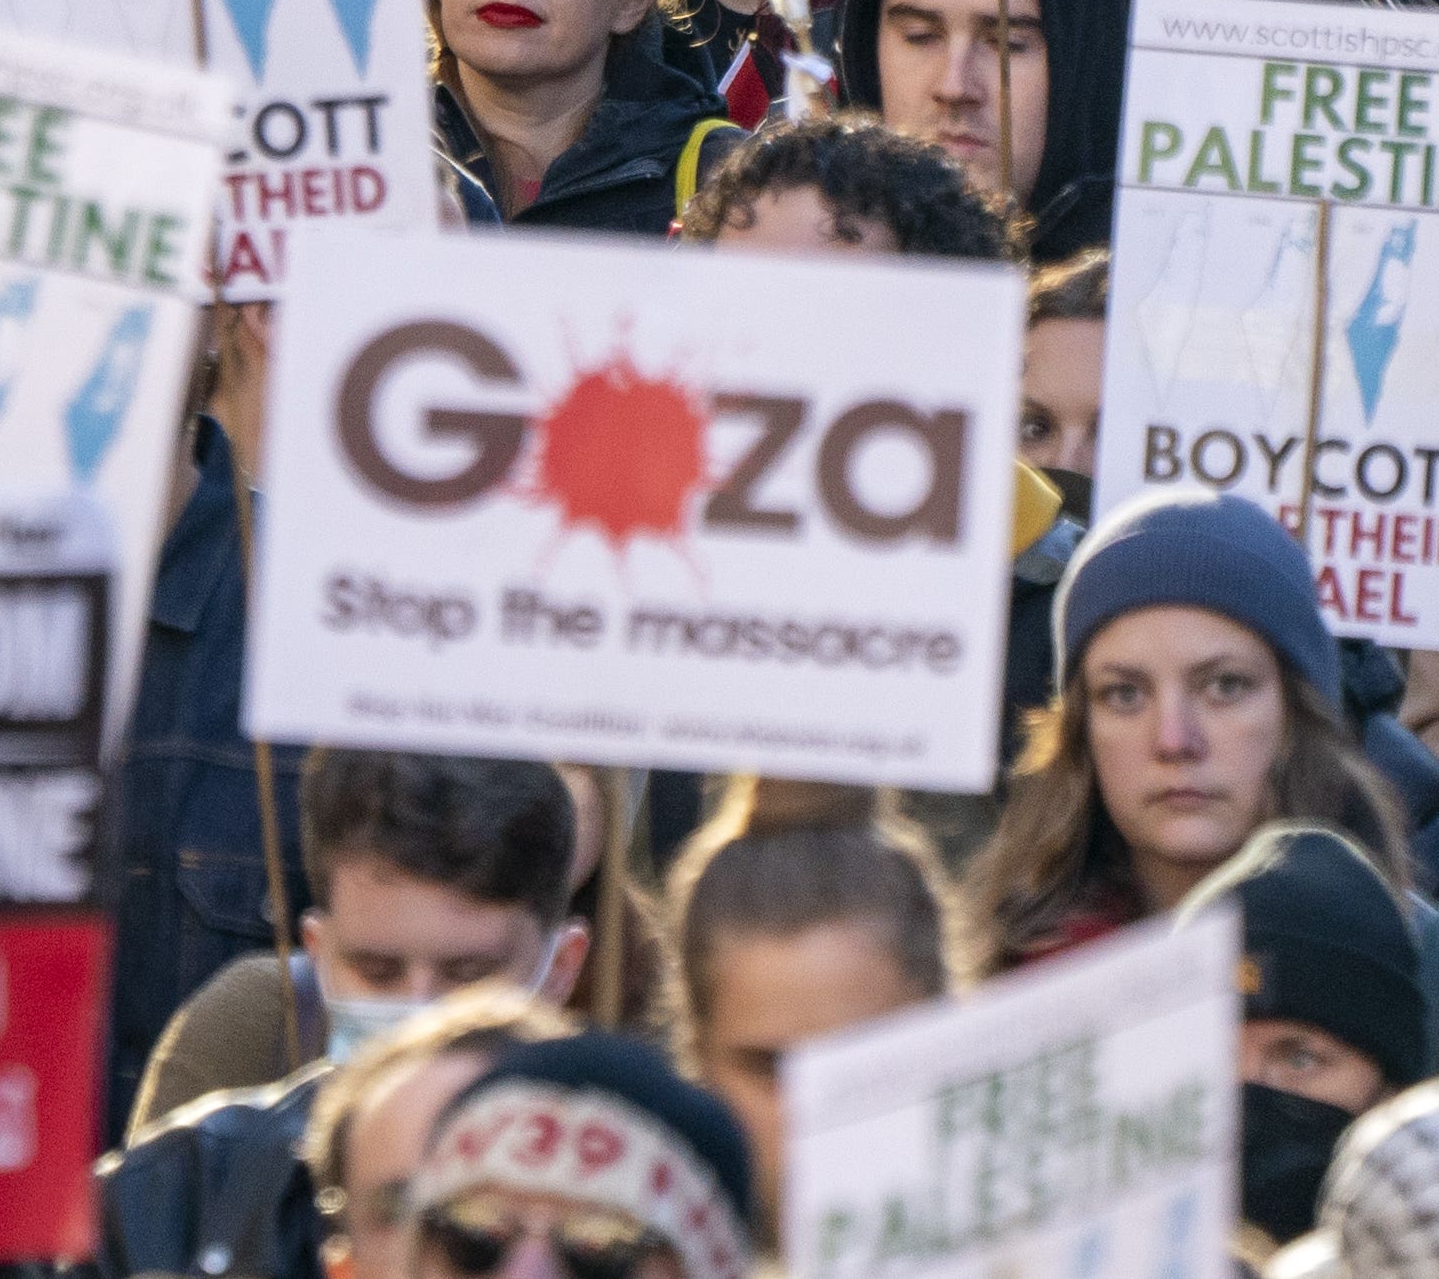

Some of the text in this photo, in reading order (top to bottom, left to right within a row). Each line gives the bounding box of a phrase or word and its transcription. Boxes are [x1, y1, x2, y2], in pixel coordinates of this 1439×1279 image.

[1259, 62, 1433, 138] FREE
[319, 573, 965, 675] Stop the massacre
